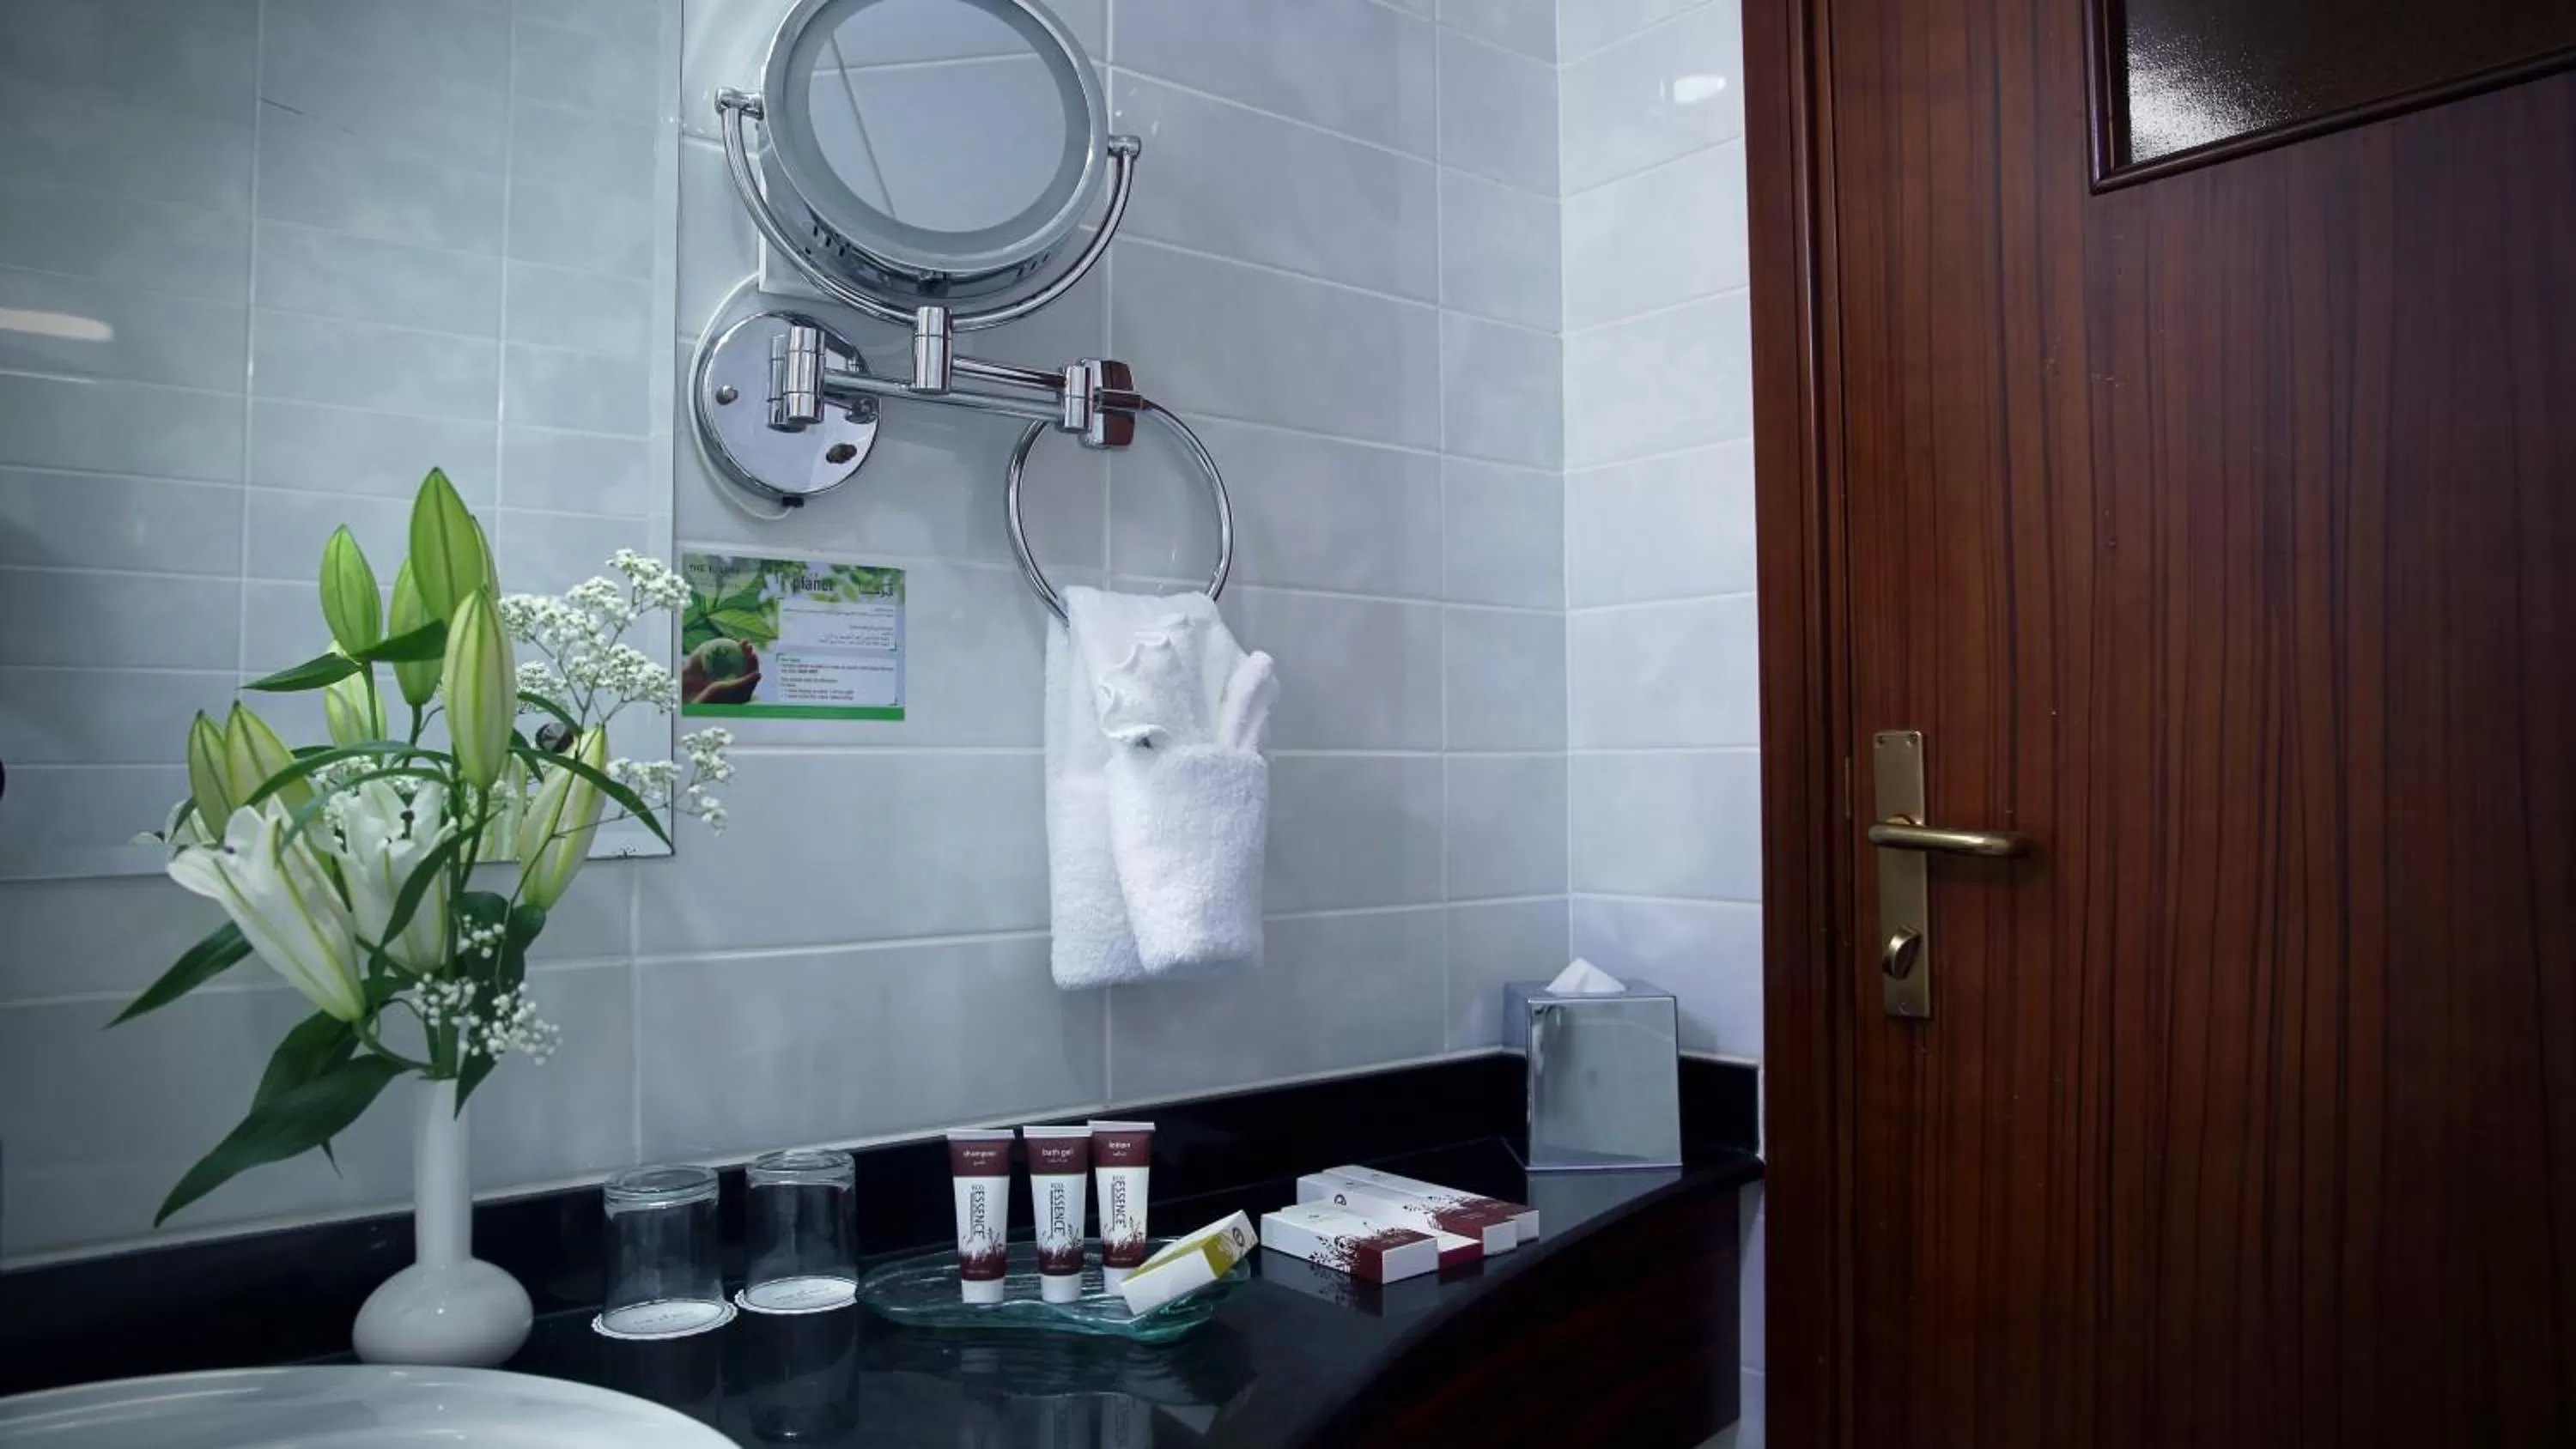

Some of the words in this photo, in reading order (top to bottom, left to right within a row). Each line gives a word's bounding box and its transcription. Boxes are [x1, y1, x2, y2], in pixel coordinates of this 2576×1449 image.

[793, 574, 834, 594] planet
[963, 1149, 998, 1159] shampoo
[1042, 1148, 1060, 1157] bath
[1060, 1148, 1073, 1159] gel
[1109, 1141, 1131, 1149] lotion
[1053, 1188, 1066, 1237] ESSENCE
[1115, 1180, 1127, 1227] ESSENCE
[973, 1190, 986, 1238] ESSENCE
